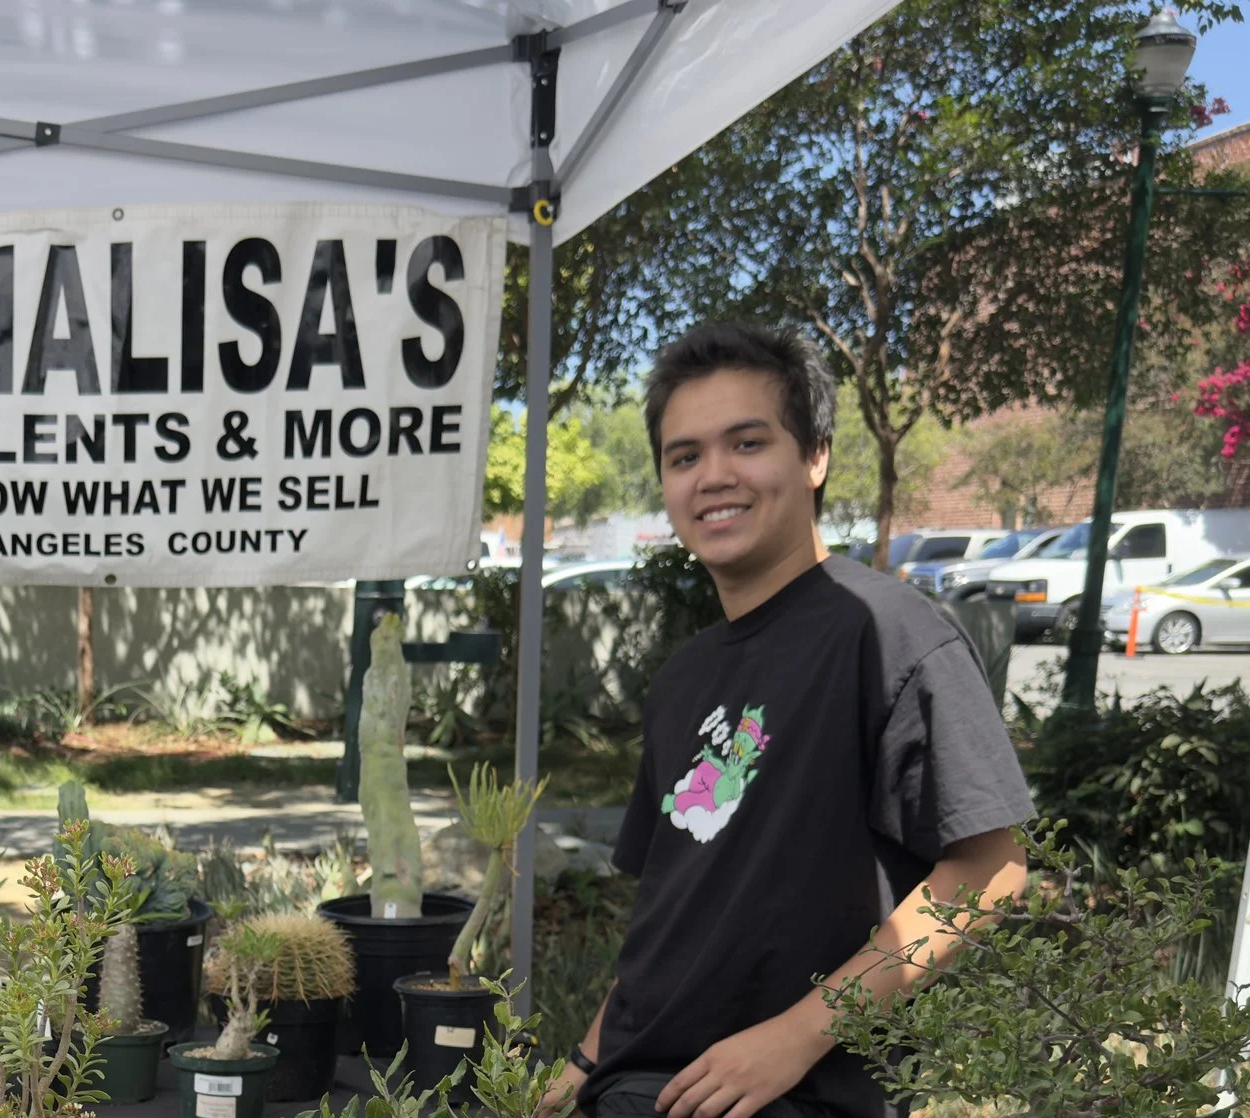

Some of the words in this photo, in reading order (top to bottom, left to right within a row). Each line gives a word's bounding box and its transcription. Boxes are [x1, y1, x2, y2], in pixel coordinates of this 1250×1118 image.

[216, 410, 259, 461] &
[284, 405, 463, 459] MORE
[62, 480, 186, 516] WHAT
[200, 477, 263, 513] WE
[278, 474, 380, 511] SELL
[168, 529, 308, 555] COUNTY
